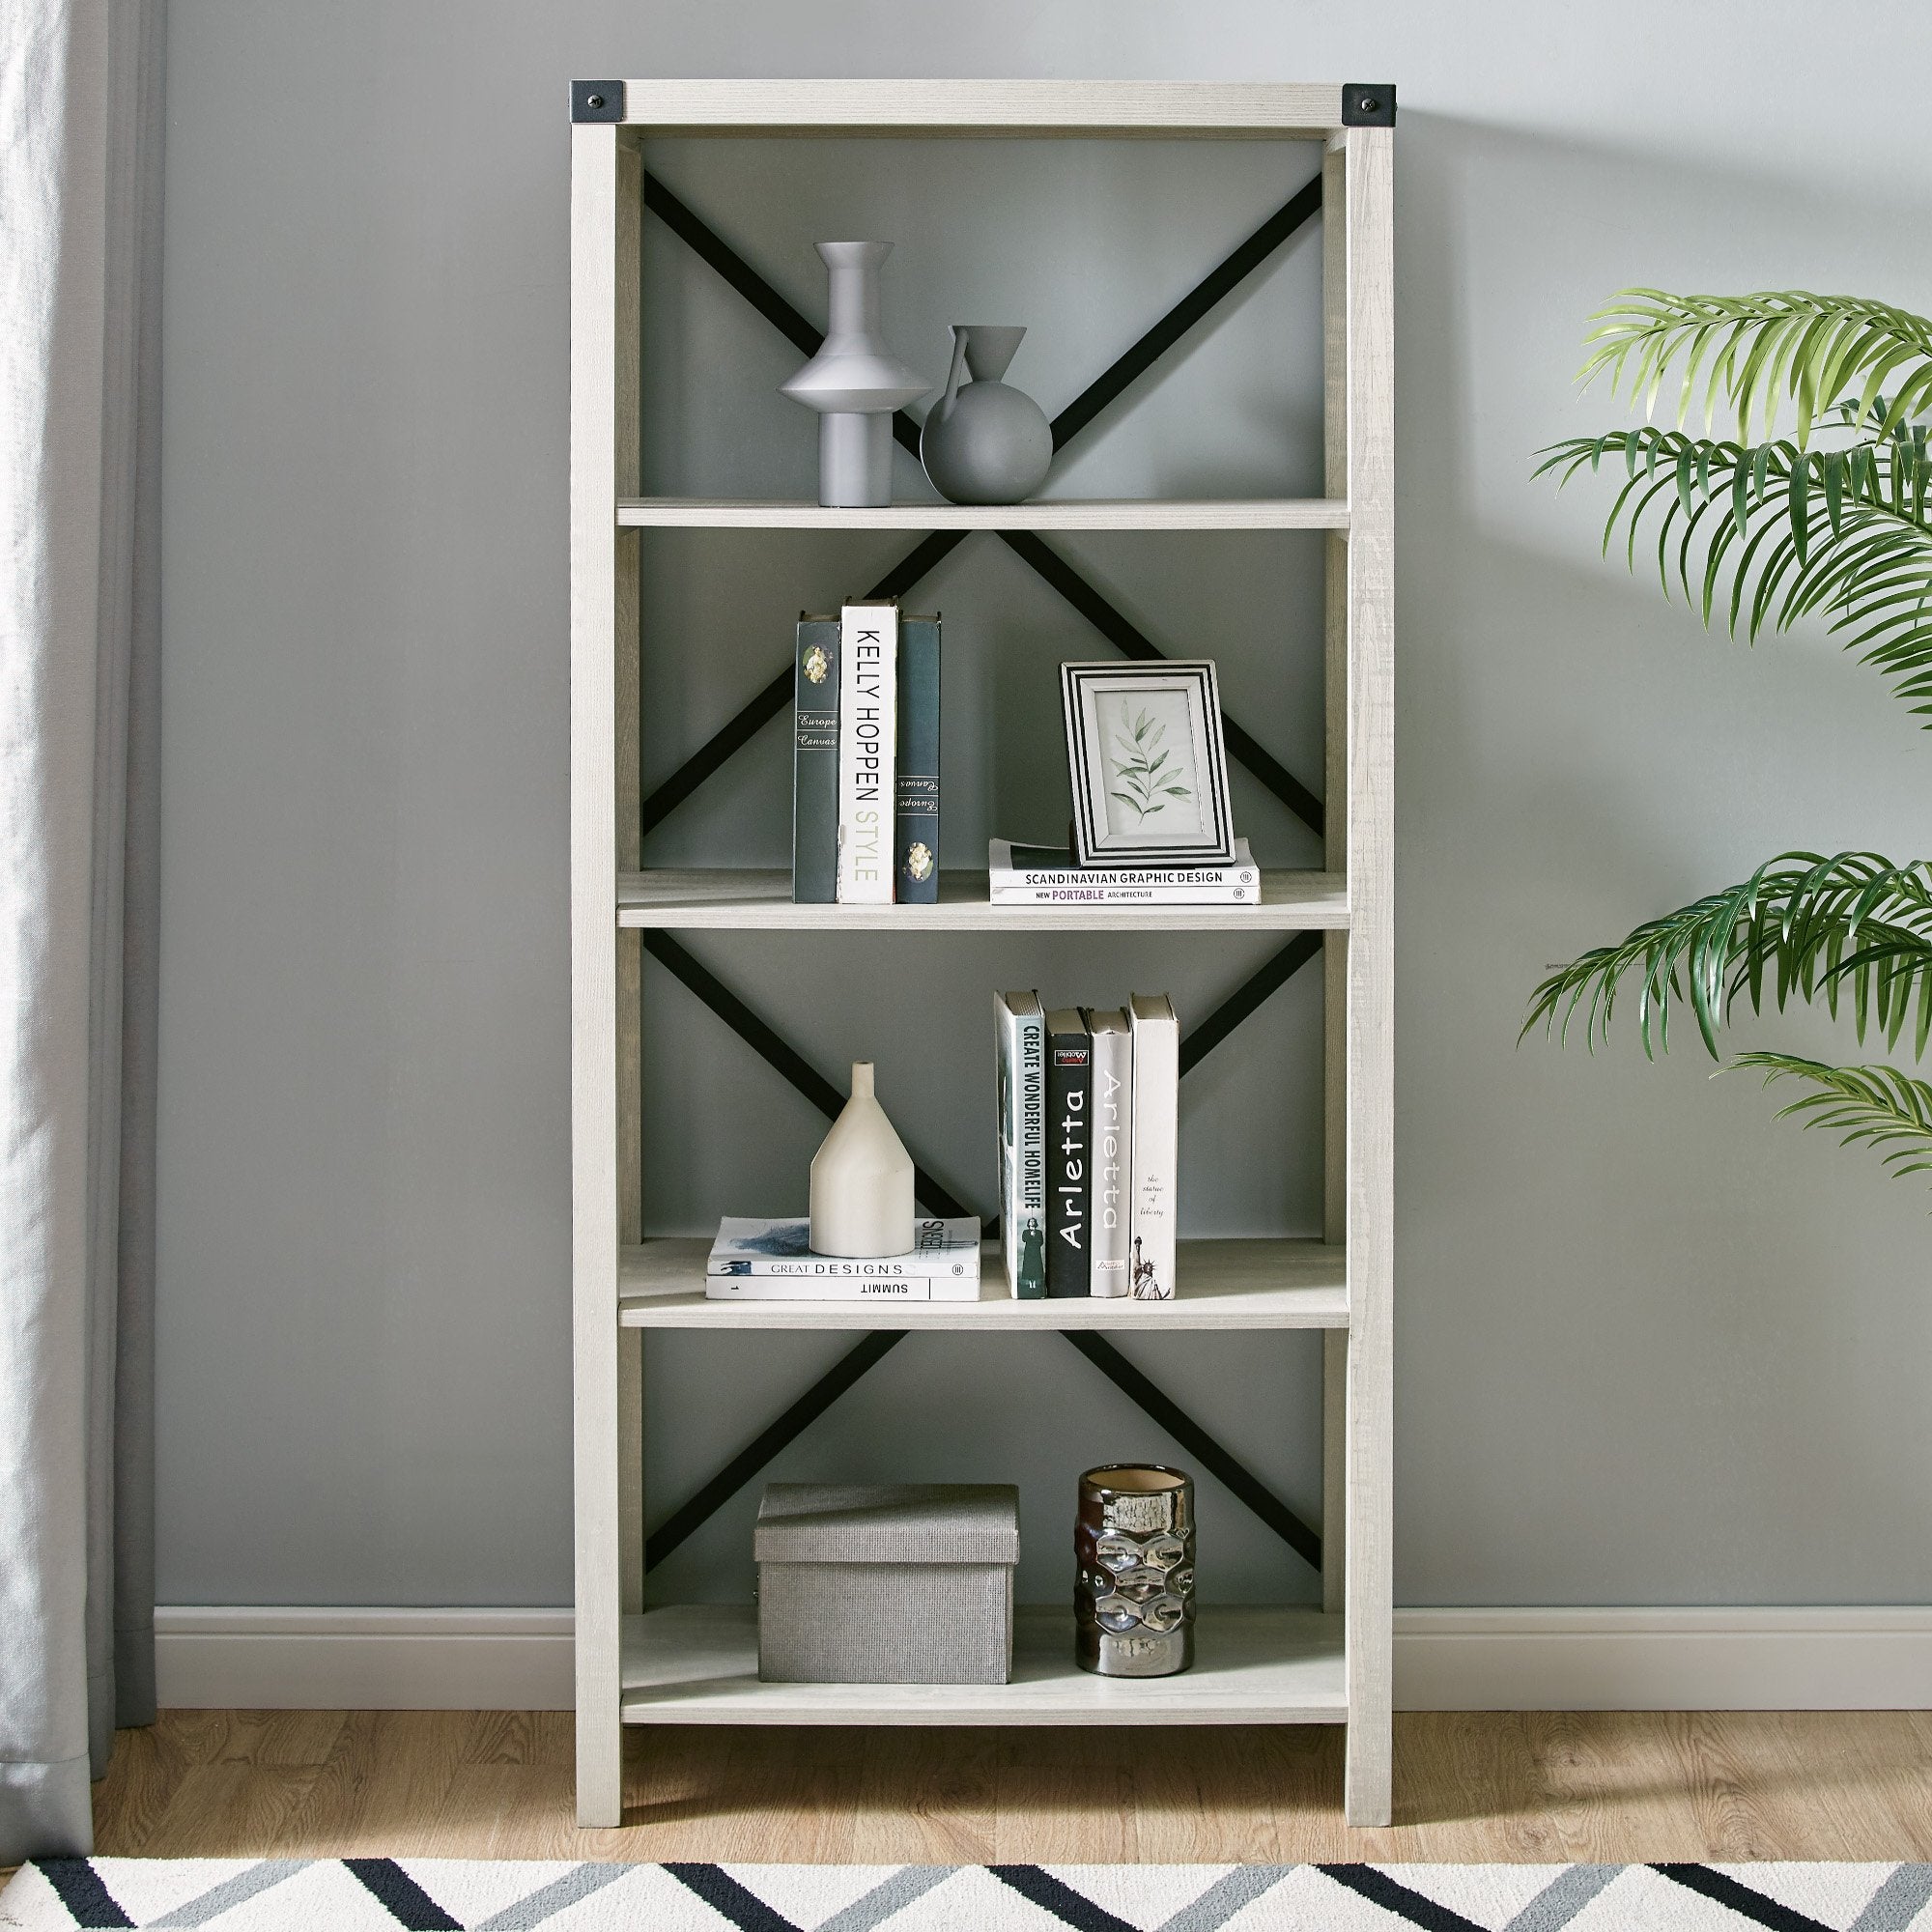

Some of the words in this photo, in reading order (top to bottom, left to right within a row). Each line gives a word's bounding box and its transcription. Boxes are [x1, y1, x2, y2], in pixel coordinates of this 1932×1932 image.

[856, 630, 880, 698] KELLY
[798, 714, 837, 727] Europe
[797, 734, 837, 747] Canvas
[856, 708, 879, 801] HOPPEN
[899, 781, 938, 792] Canvas
[899, 800, 937, 811] Europe
[855, 810, 878, 881] STYLE
[1025, 873, 1117, 885] SCANDINAVIAN
[1120, 872, 1175, 884] GRAPHIC
[1177, 871, 1223, 883] DESIGN
[1052, 890, 1104, 900] PORTABLE
[1023, 1025, 1040, 1068] CREATE
[1023, 1072, 1040, 1147] WONDERFUL
[1103, 1069, 1122, 1230] Arletta
[1058, 1090, 1084, 1250] Arletta
[1024, 1150, 1041, 1209] HOMELIFE
[1140, 1208, 1164, 1218] liberty
[771, 1264, 810, 1273] GREAT
[814, 1264, 903, 1274] DESIGNS
[860, 1284, 908, 1293] SUMMIT
